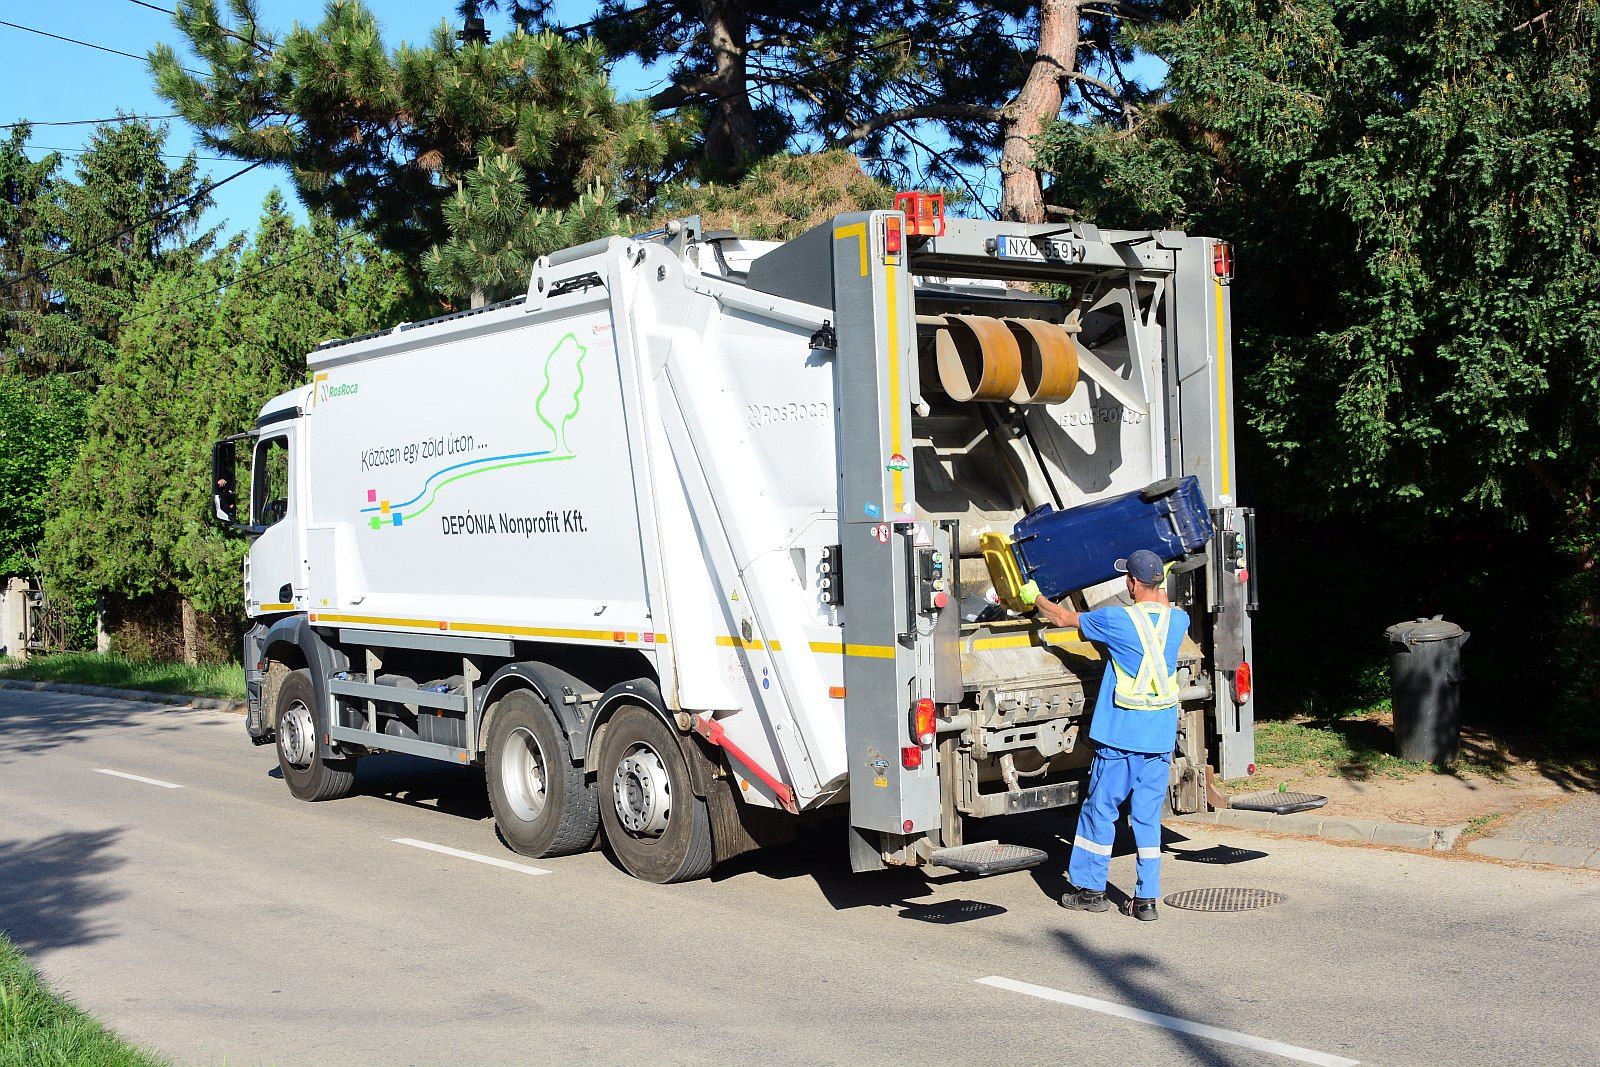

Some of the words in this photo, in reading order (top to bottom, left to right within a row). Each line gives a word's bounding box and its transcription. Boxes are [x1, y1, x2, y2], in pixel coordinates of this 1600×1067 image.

[1009, 238, 1069, 259] NXD-559
[329, 383, 359, 398] RosRoca
[763, 402, 829, 424] RosRoca
[361, 446, 401, 472] Közösen
[403, 443, 420, 464] egy
[422, 436, 444, 459] zöld
[447, 432, 474, 455] úton
[441, 509, 497, 535] DEPÓNIA
[499, 511, 560, 539] Nonprofit
[562, 509, 588, 533] Kft.
